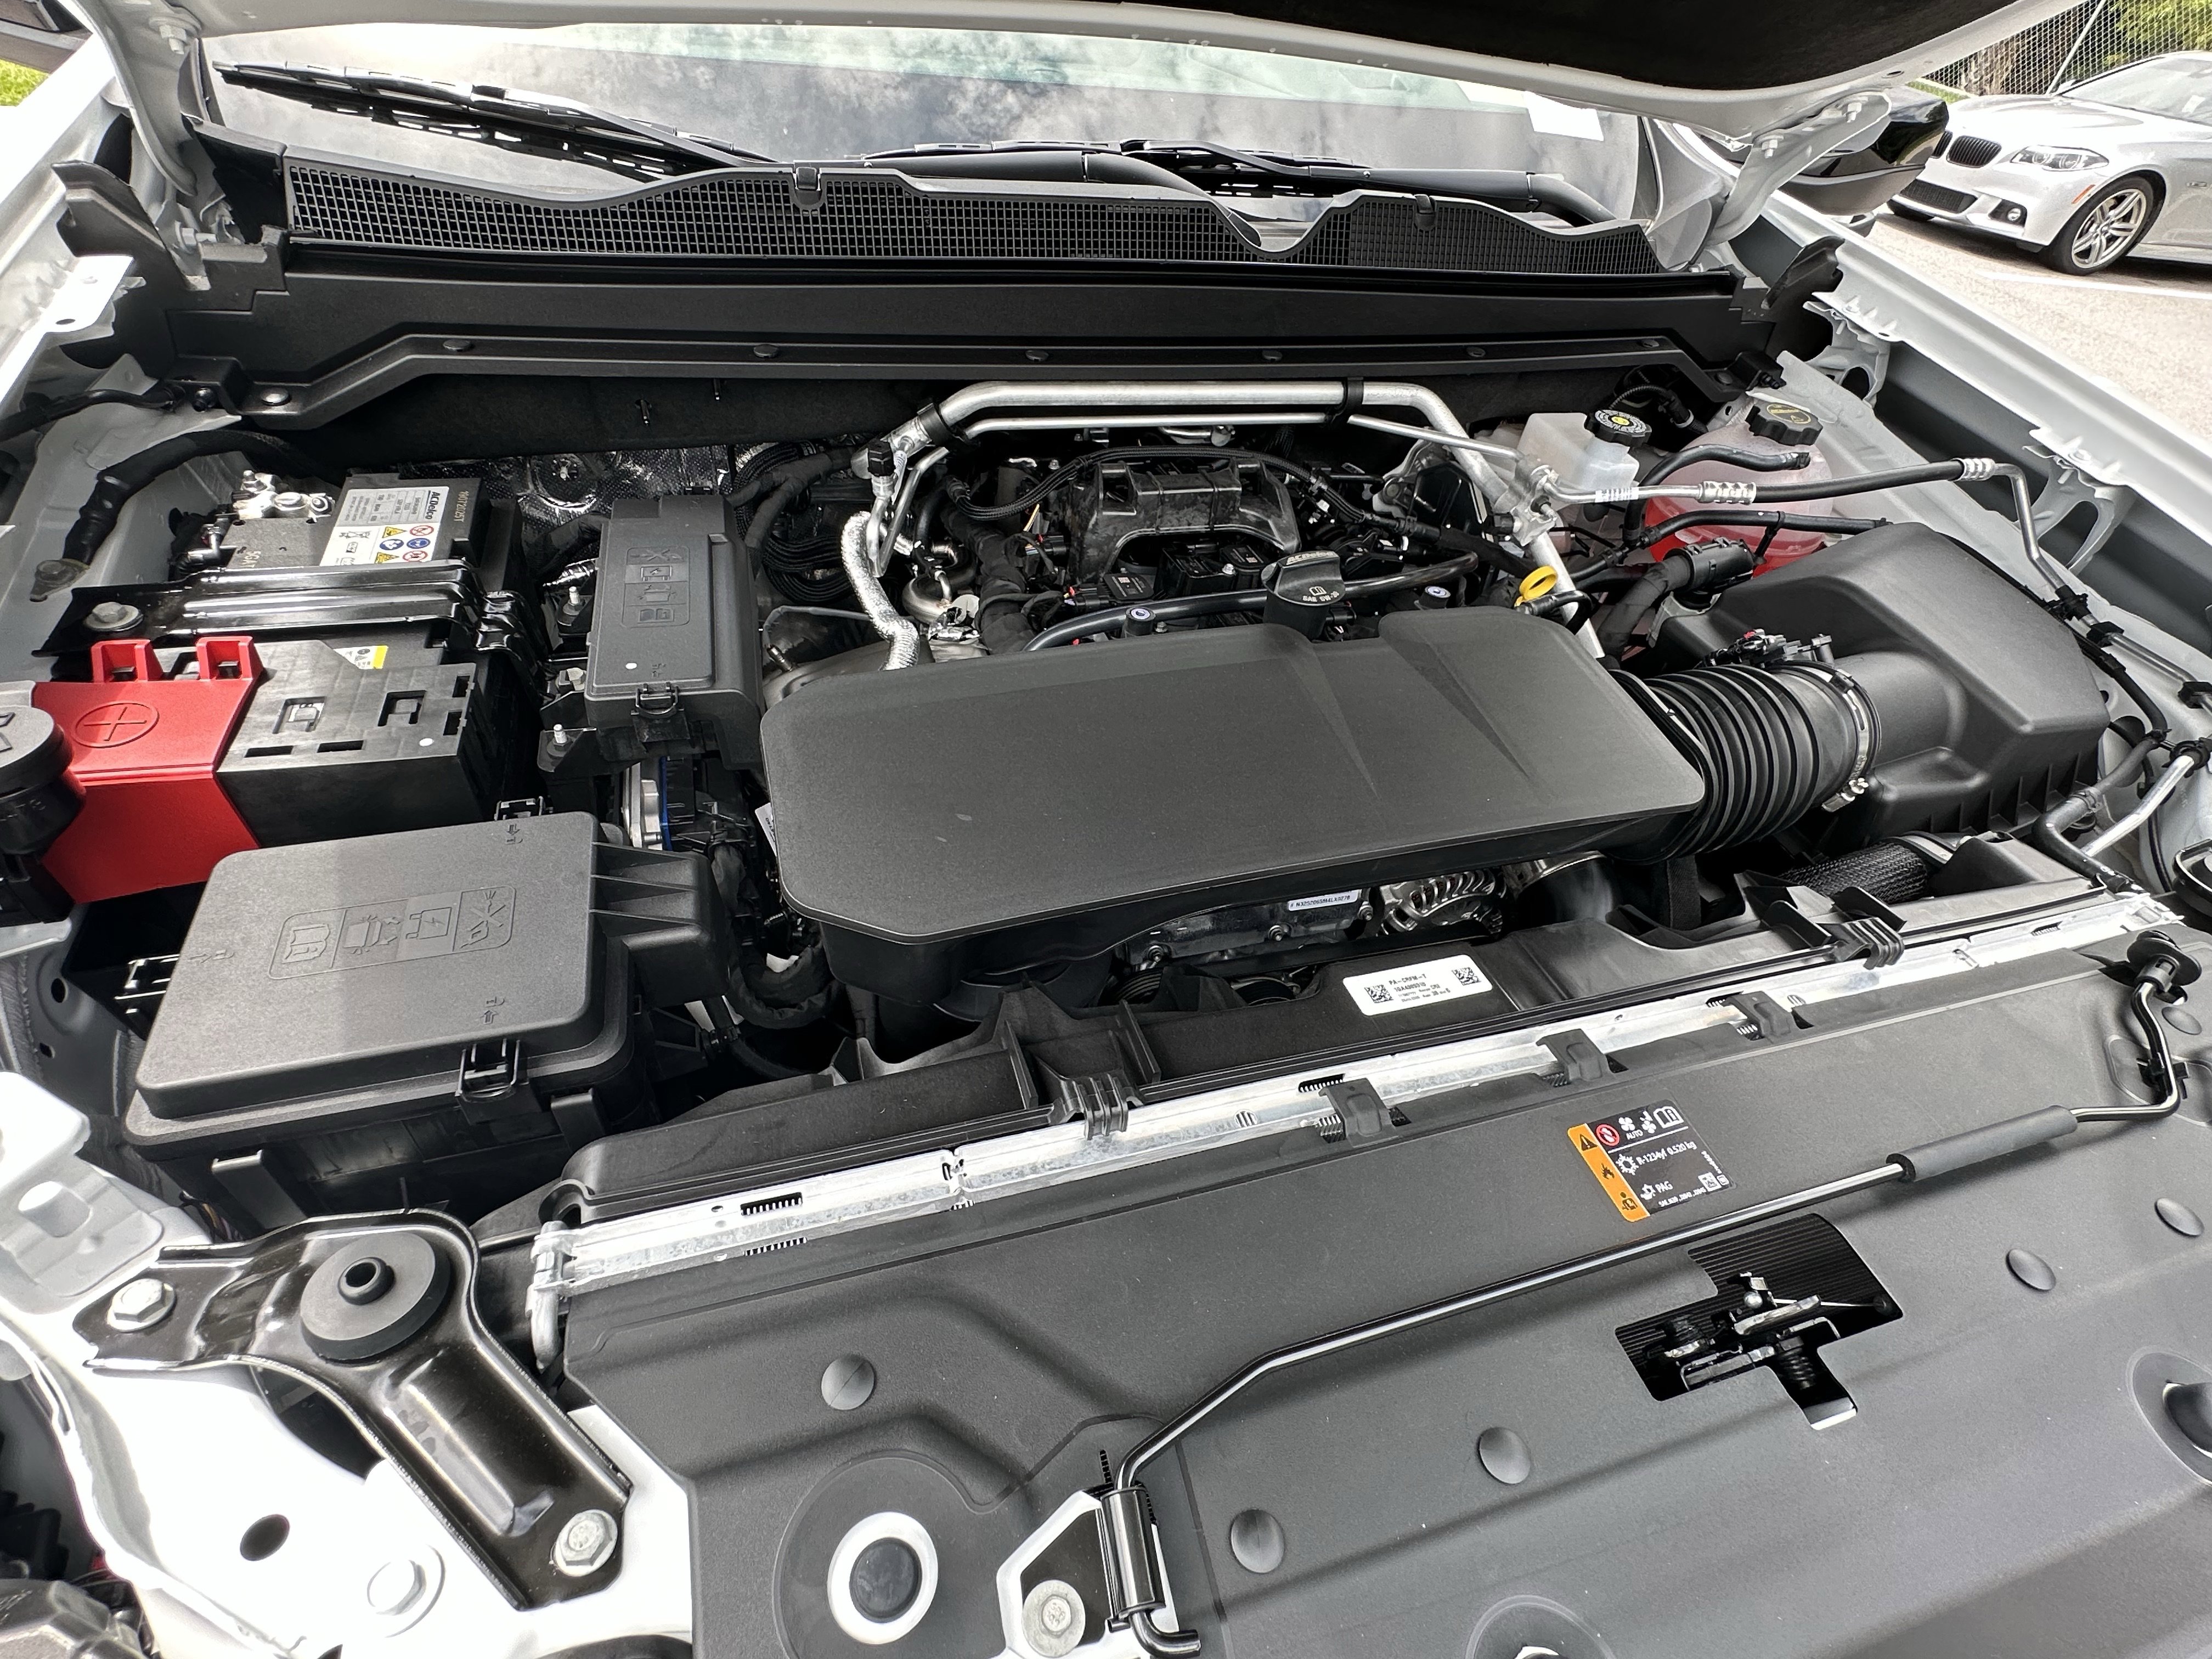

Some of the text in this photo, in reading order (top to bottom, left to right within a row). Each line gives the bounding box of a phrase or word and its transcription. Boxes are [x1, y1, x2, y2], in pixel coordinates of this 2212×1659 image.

[425, 491, 441, 520] ACDelco
[1626, 1129, 1644, 1140] AUTO
[1635, 1141, 1697, 1165] R-1234yf 0.520 kg
[1655, 1181, 1673, 1193] PAG
